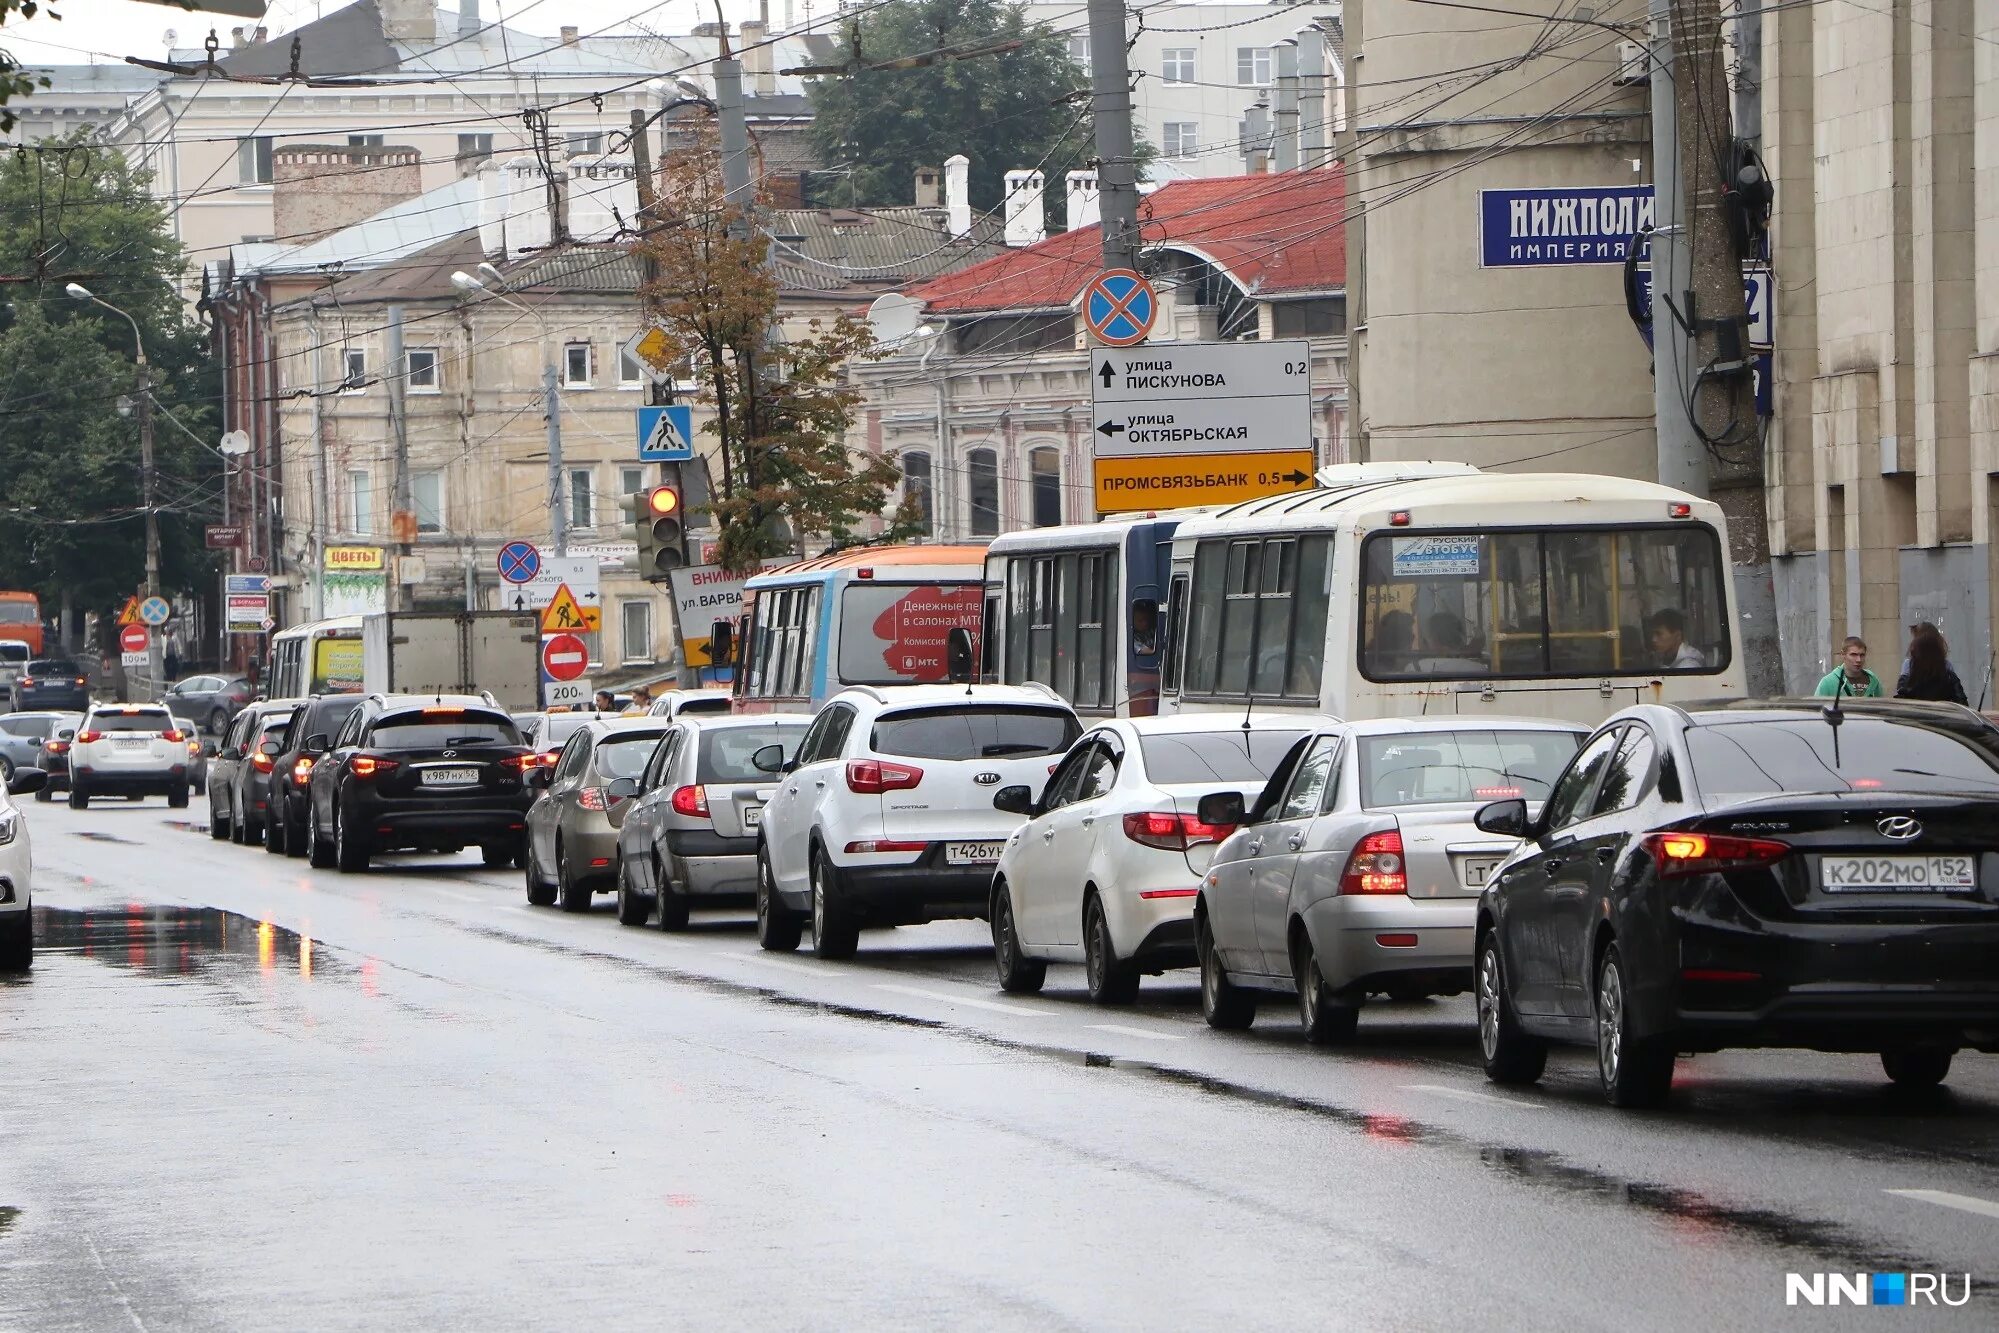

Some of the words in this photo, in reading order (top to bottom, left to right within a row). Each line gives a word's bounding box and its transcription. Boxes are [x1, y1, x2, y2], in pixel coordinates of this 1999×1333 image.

[1510, 243, 1626, 259] ИМПЕРИЯ
[1126, 360, 1173, 374] улица
[1284, 362, 1307, 377] 0,2
[1126, 374, 1226, 389] ПИСКУНОВА
[1128, 413, 1175, 428] улица
[1128, 426, 1248, 443] ОКТЯБРЬСКАЯ
[1103, 474, 1249, 490] ПРОМСВЯЗЬБАНК
[1258, 472, 1280, 487] 0,5
[332, 551, 376, 563] ЦВЕТЫ
[903, 601, 962, 613] Денежные
[903, 618, 910, 626] в
[913, 617, 958, 626] салонах
[904, 637, 946, 646] Комиссия
